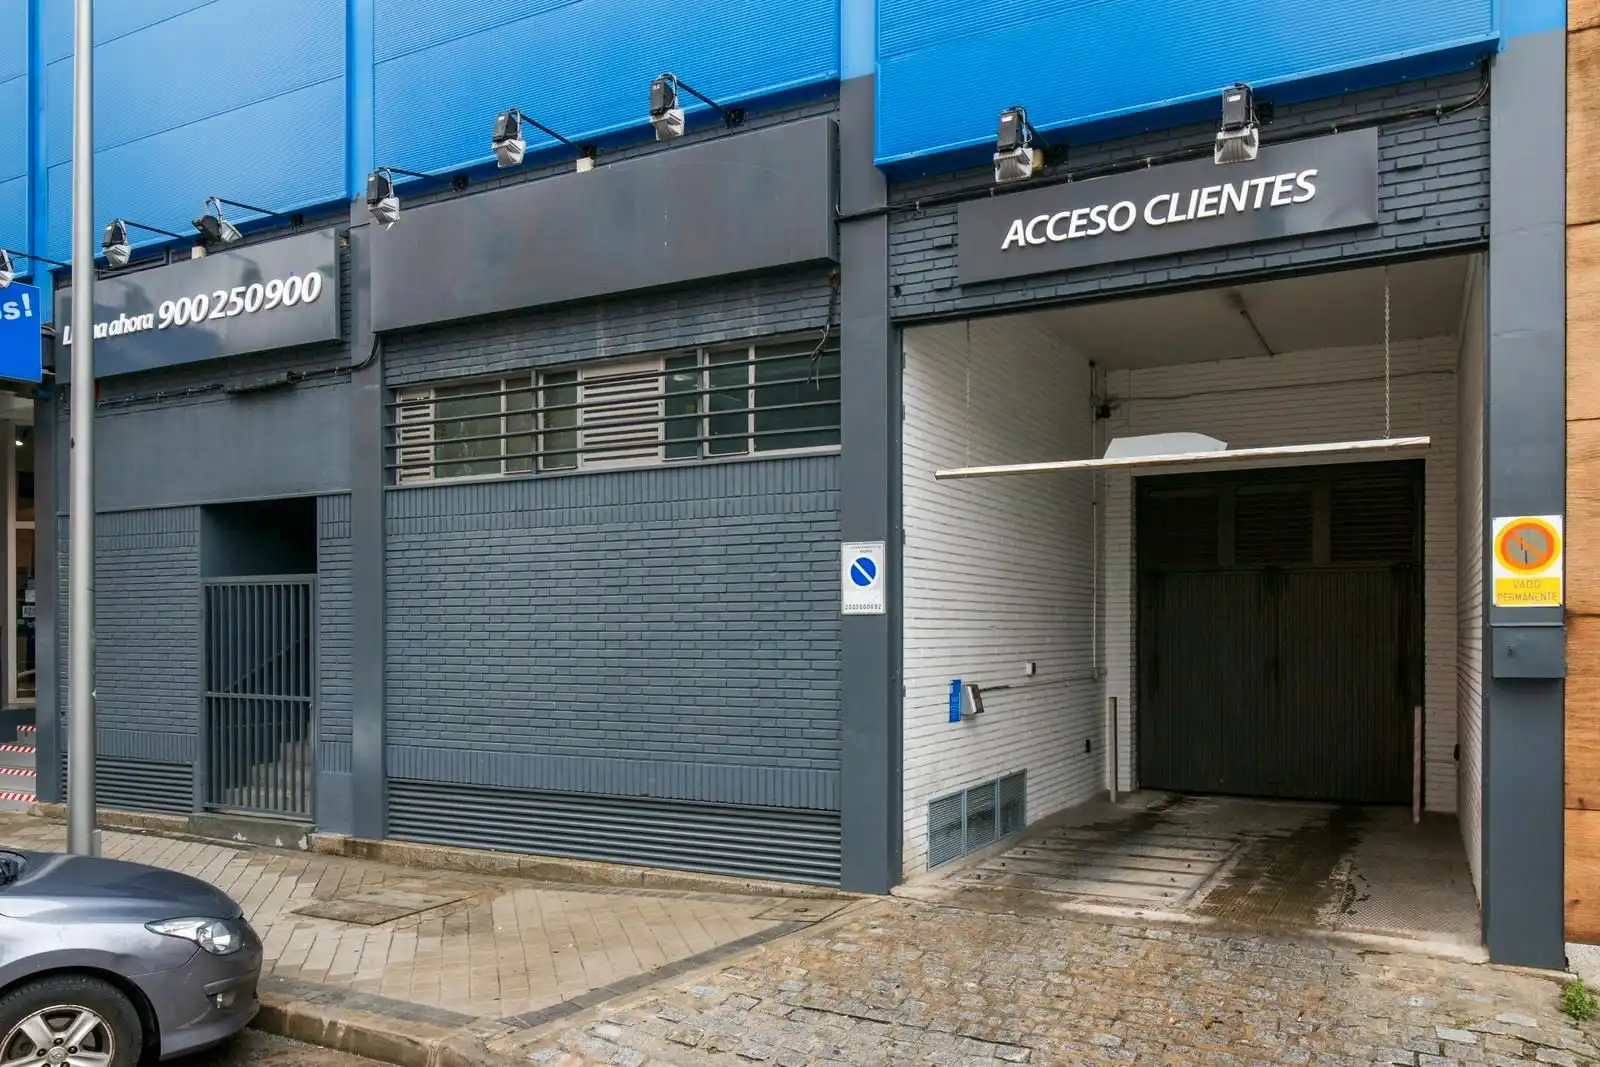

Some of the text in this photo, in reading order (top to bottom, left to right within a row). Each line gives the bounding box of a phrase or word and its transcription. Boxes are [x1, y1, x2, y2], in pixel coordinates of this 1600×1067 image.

[1001, 169, 1318, 250] ACCESO CLIENTES
[0, 293, 32, 321] s!
[108, 313, 155, 337] ahora
[158, 271, 322, 330] 900250900
[1497, 591, 1557, 602] PERMANENTE
[1512, 579, 1541, 589] VADO
